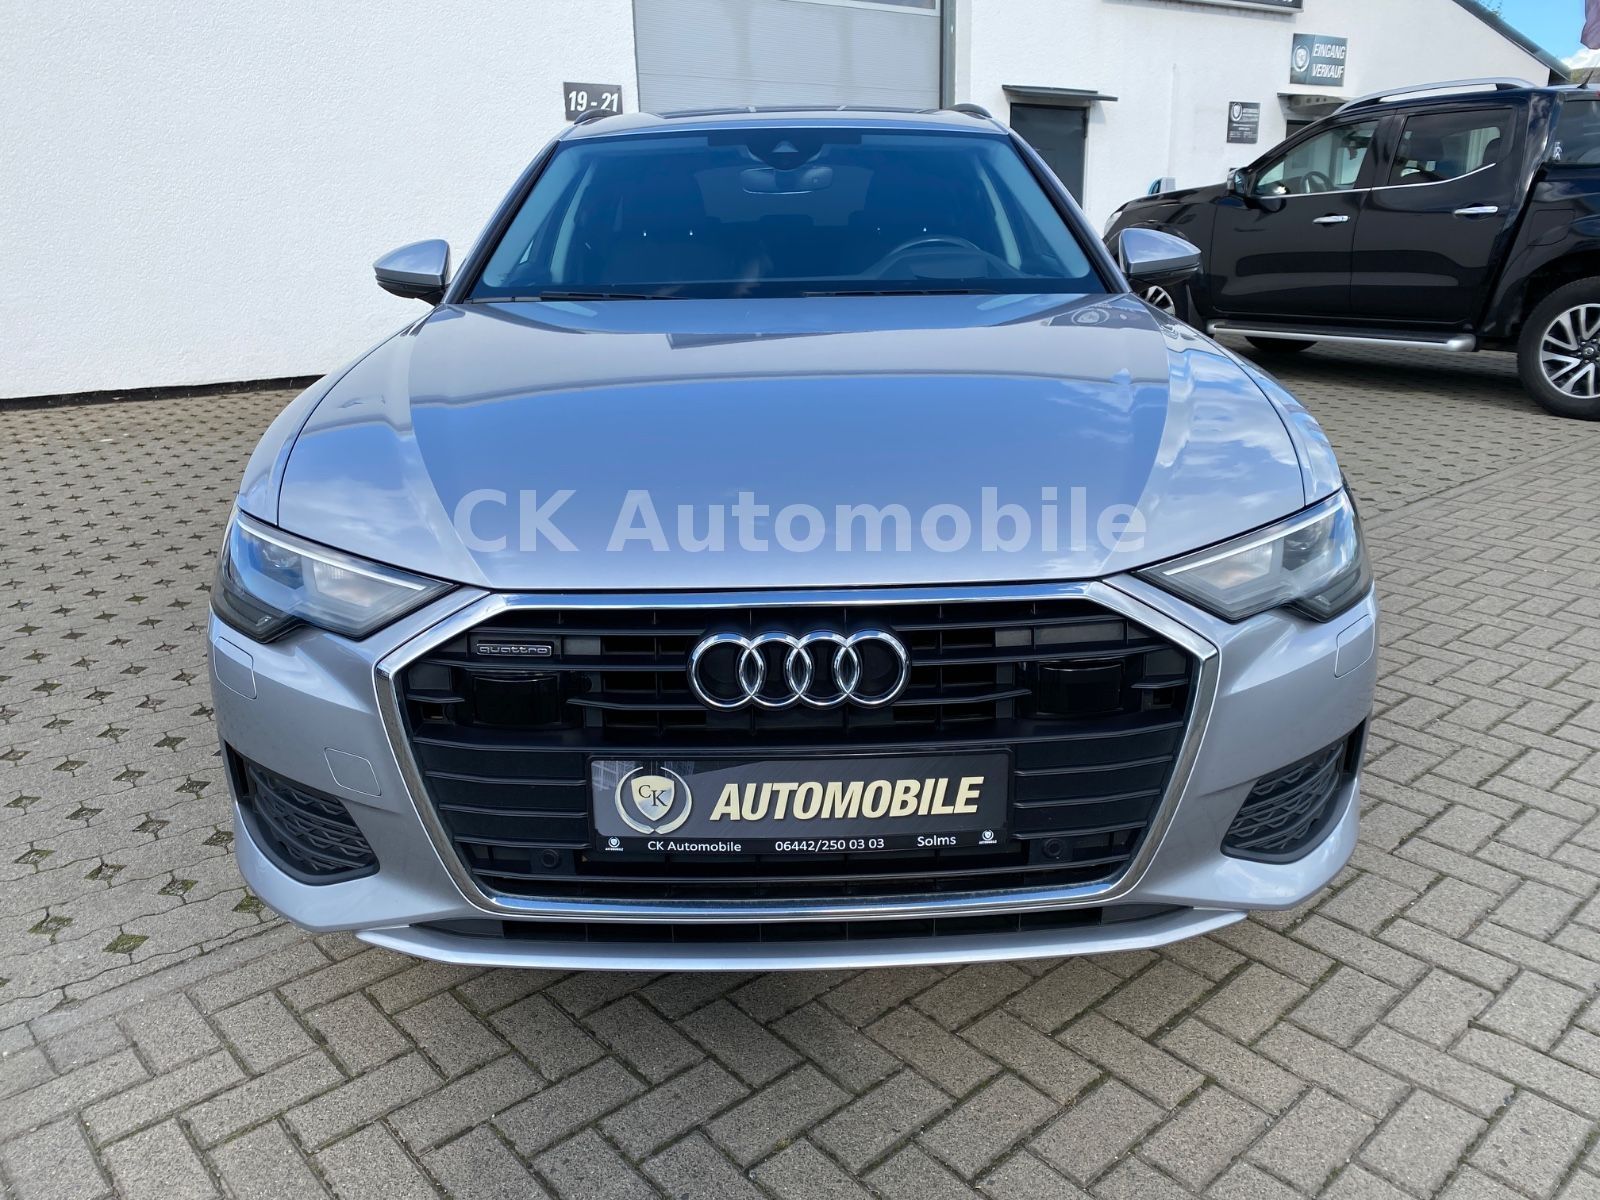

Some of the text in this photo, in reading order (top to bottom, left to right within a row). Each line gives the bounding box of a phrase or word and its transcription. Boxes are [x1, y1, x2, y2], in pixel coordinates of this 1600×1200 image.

[1312, 43, 1346, 59] EINGANG
[1311, 63, 1345, 79] VERKAUF
[479, 645, 549, 655] quattro
[709, 776, 985, 822] AUTOMOBILE
[647, 840, 742, 853] CK Automobile
[774, 837, 886, 852] 06442/250 03 03
[916, 834, 957, 847] Solms
